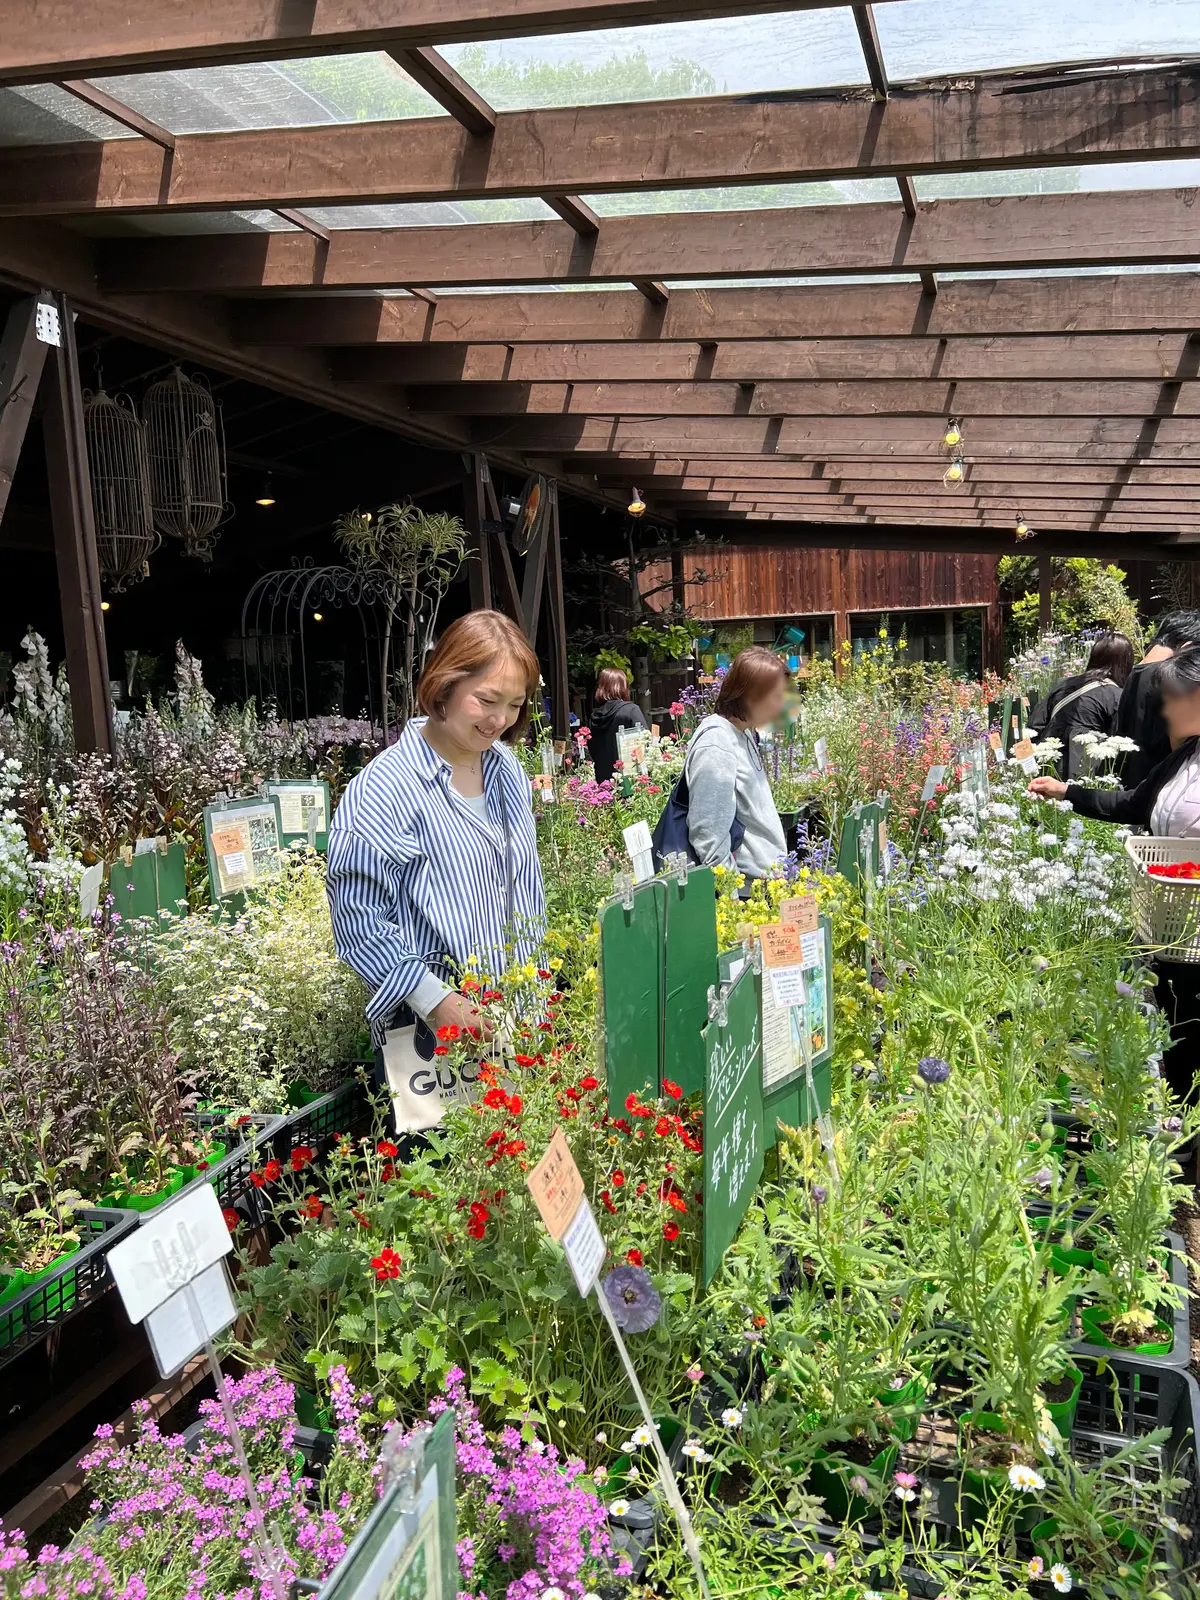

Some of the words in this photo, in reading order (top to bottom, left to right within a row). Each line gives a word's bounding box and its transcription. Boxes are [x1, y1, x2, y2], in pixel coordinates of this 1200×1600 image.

[710, 1034, 732, 1089] 珍しい
[715, 1014, 758, 1113] ポピーシリーズ
[439, 1089, 457, 1099] MADE
